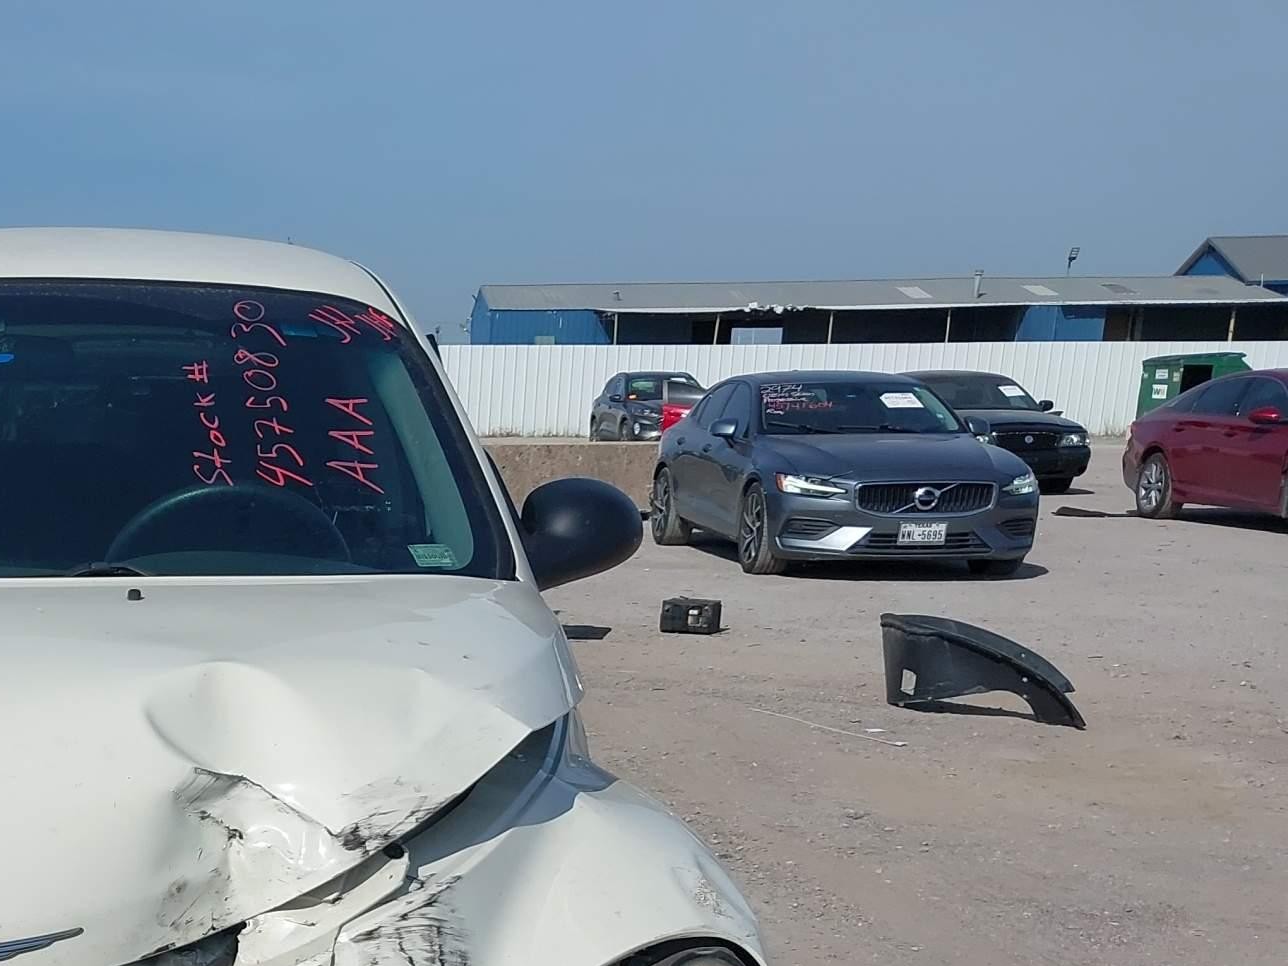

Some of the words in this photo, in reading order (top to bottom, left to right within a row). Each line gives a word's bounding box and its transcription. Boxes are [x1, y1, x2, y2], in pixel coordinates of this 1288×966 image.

[182, 360, 209, 383] #
[230, 300, 314, 486] 45750830
[193, 392, 234, 486] Stock
